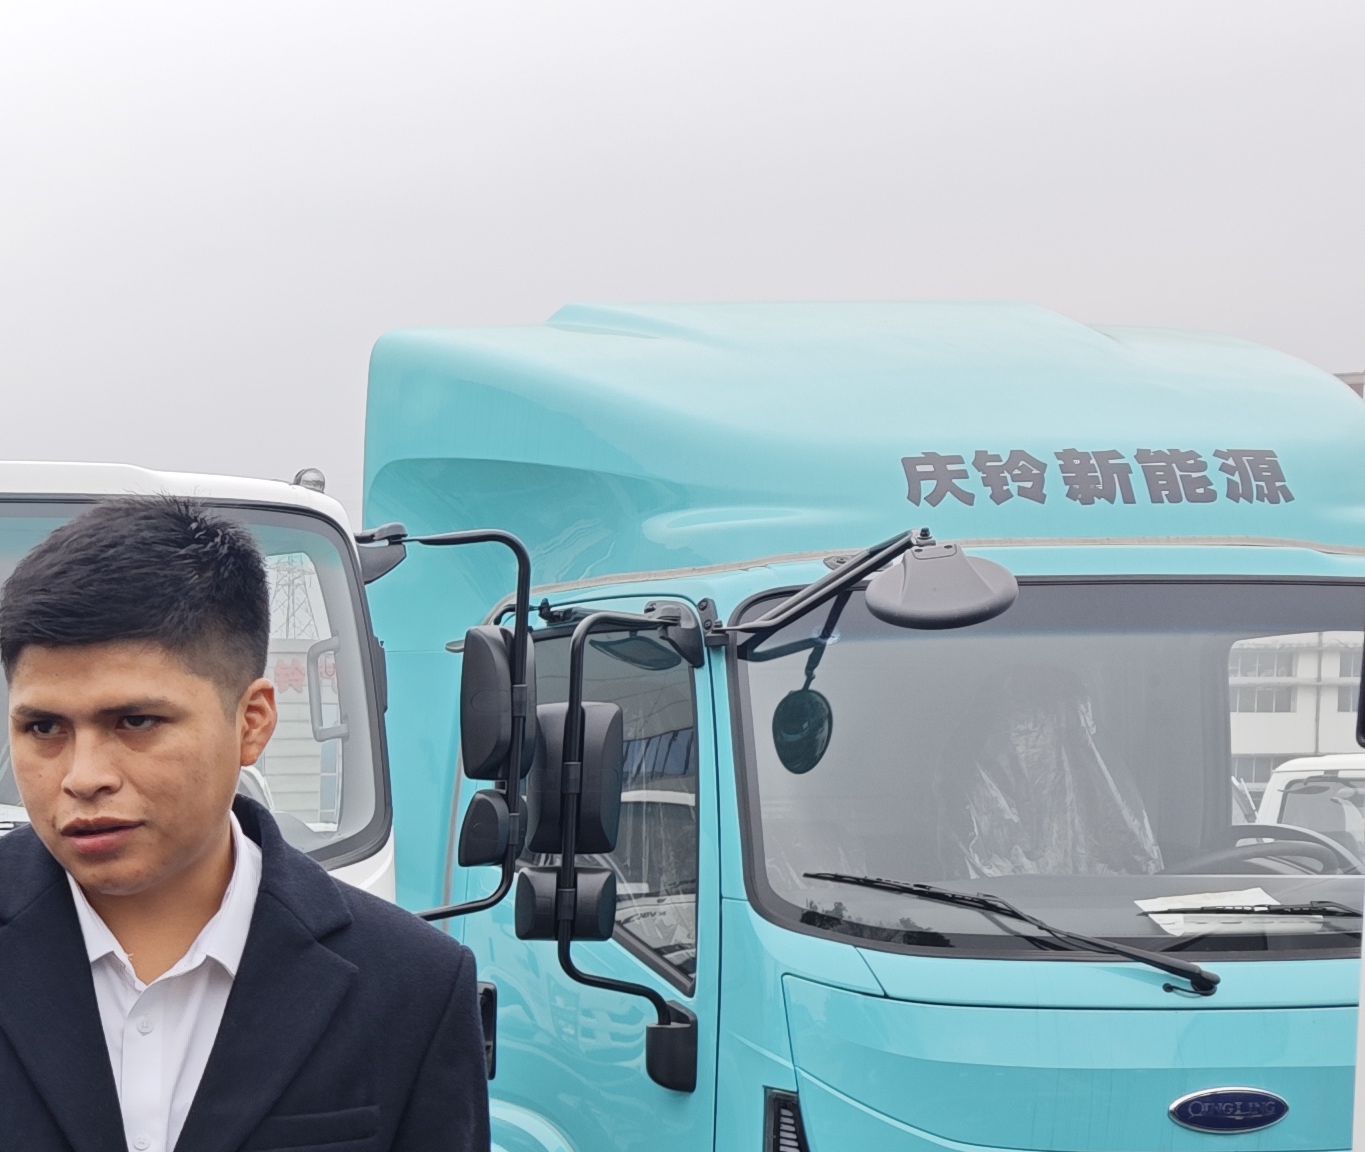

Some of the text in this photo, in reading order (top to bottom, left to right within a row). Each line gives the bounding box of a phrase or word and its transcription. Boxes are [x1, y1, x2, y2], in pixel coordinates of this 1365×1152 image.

[901, 448, 1295, 507] 庆铃新能源
